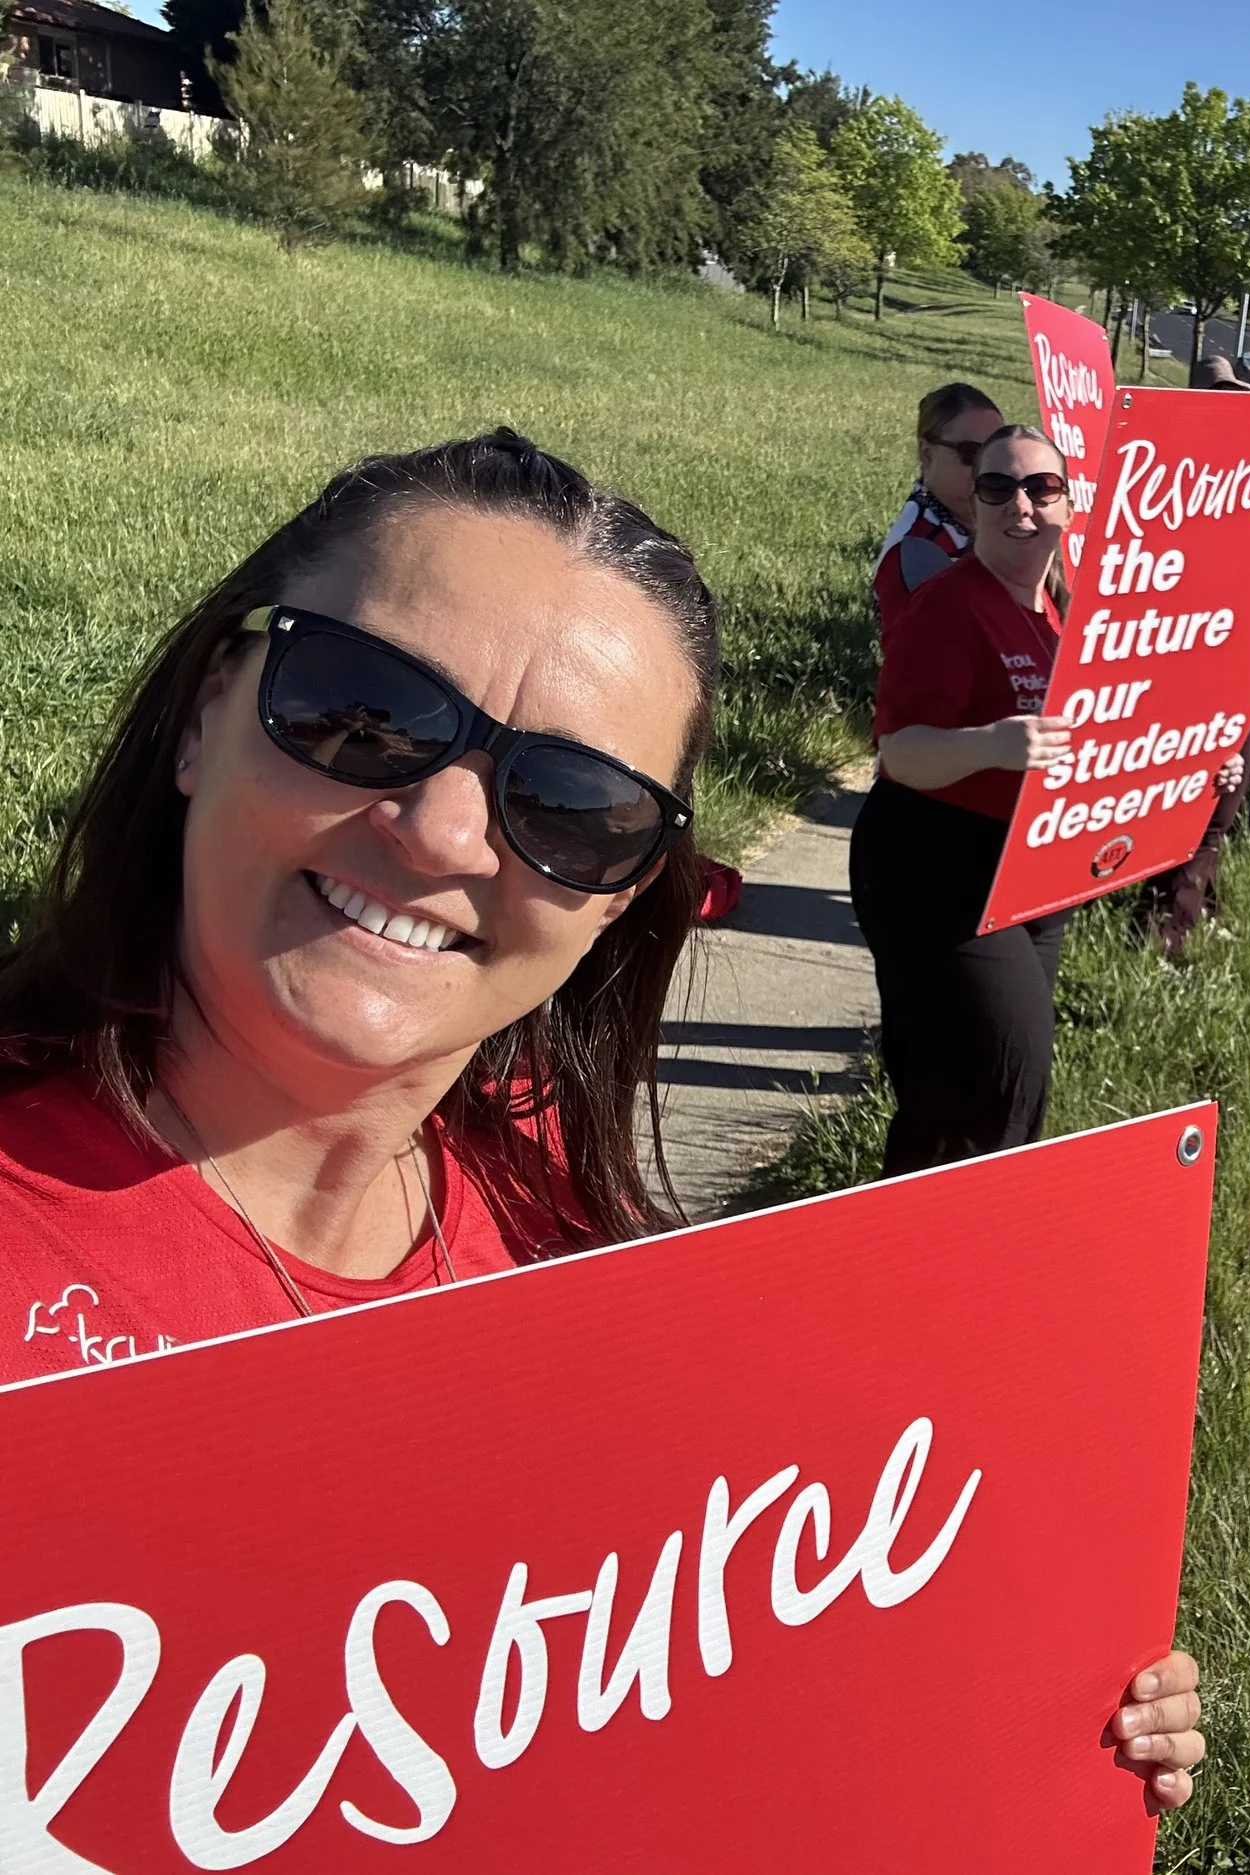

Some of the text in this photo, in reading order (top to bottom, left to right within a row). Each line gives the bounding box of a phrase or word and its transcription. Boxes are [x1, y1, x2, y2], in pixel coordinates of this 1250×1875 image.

[1051, 411, 1086, 459] the
[1098, 538, 1185, 597] the
[1079, 607, 1234, 665] future
[1062, 679, 1152, 729] our
[1043, 711, 1246, 790] students
[1027, 769, 1208, 849] deserve
[0, 1417, 982, 1875] Resource
